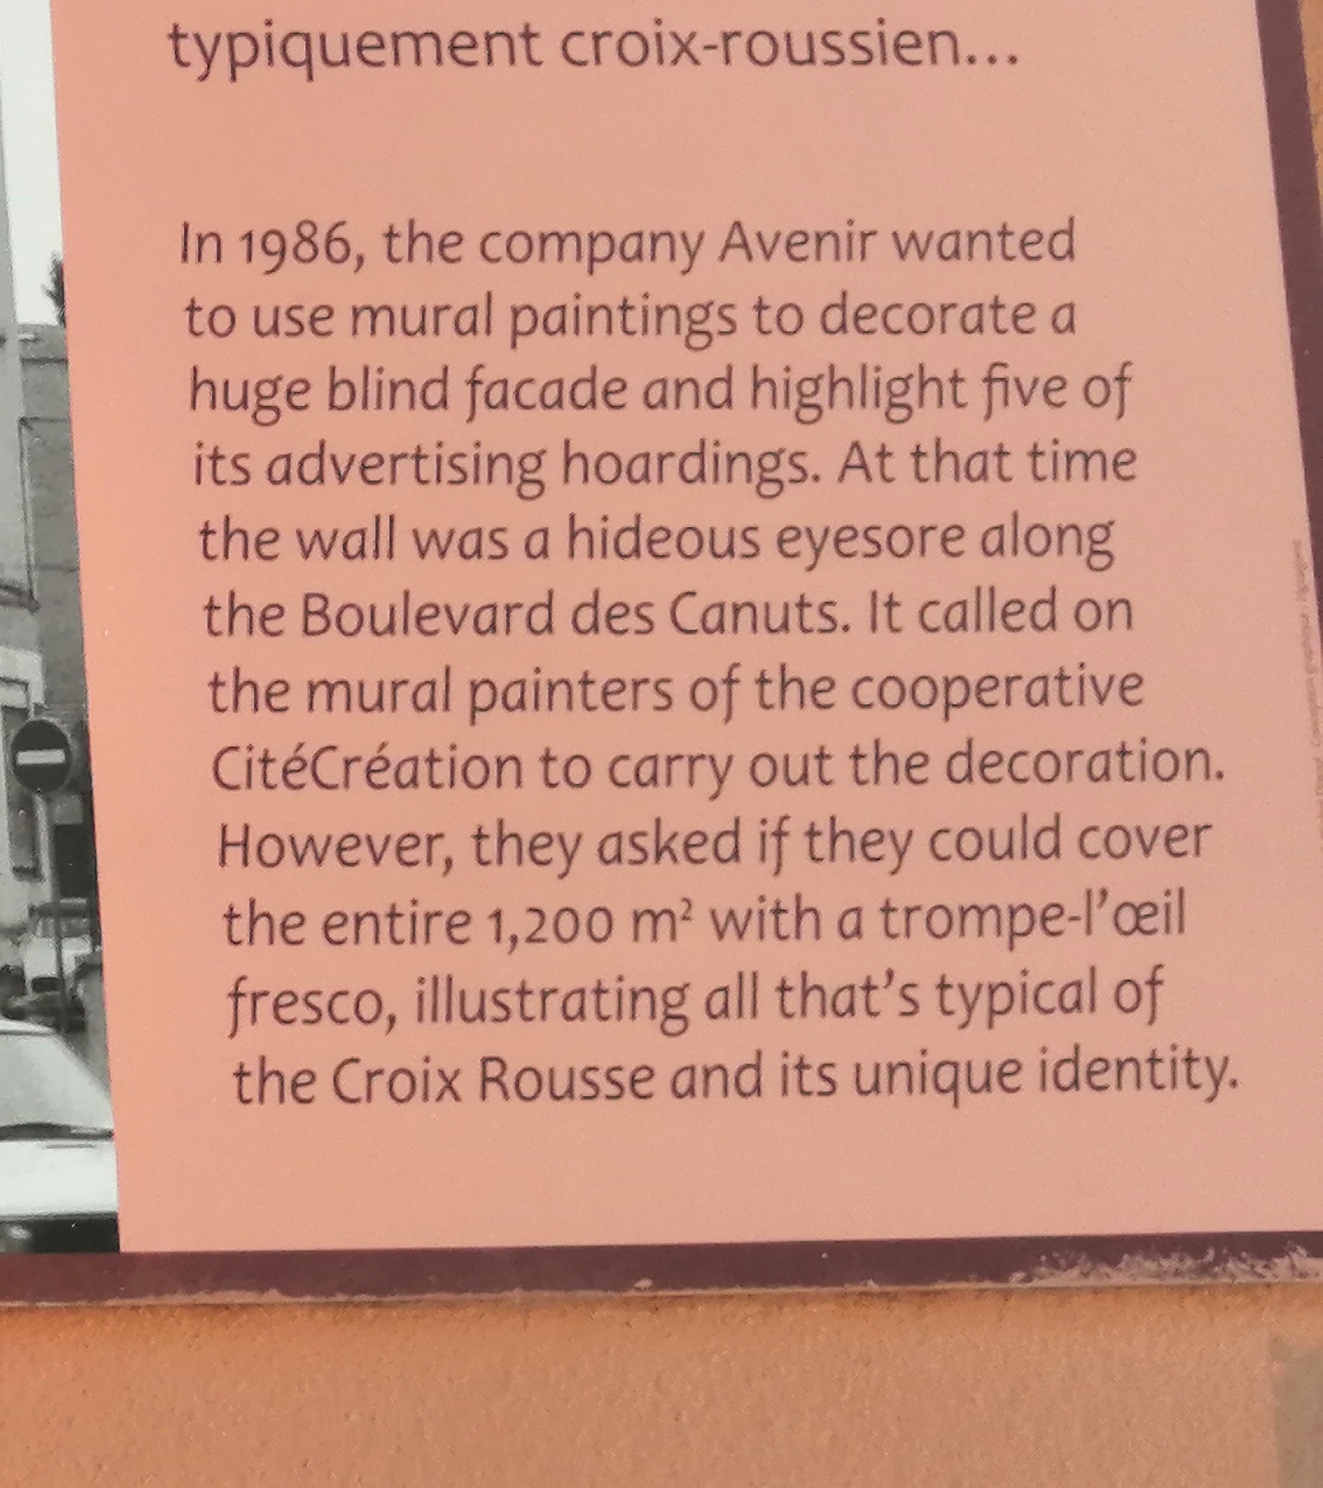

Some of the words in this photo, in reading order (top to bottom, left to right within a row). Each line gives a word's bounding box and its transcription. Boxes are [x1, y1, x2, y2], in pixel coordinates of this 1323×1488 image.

[166, 18, 544, 84] typiquement
[560, 16, 1019, 68] croix-roussien...
[180, 220, 223, 265] In
[238, 218, 366, 276] 1986,
[381, 217, 465, 265] the
[479, 229, 706, 277] company
[717, 218, 879, 264] Avenir
[890, 214, 1076, 263] wanted
[182, 296, 237, 339] to
[253, 303, 335, 339] use
[351, 290, 494, 338] mural
[510, 291, 738, 353] paintings
[751, 295, 805, 337] to
[819, 289, 1037, 337] decorate
[1050, 301, 1076, 335] a
[189, 364, 312, 428] huge
[328, 363, 450, 412] blind
[464, 363, 628, 425] facade
[642, 362, 734, 411] and
[750, 361, 969, 426] highlight
[981, 360, 1068, 423] five
[1082, 360, 1134, 422] of
[194, 440, 252, 487] its
[264, 438, 548, 502] advertising
[562, 437, 821, 501] hoardings.
[836, 440, 896, 484] At
[909, 435, 1014, 484] that
[1026, 437, 1138, 483] time
[197, 513, 281, 563] the
[295, 512, 396, 562] wall
[411, 526, 510, 561] was
[523, 526, 550, 561] a
[567, 511, 761, 561] hideous
[776, 523, 966, 573] eyesore
[979, 509, 1116, 573] along
[202, 589, 286, 638] the
[301, 587, 555, 638] Boulevard
[570, 587, 655, 637] des
[668, 590, 852, 636] Canuts.
[869, 589, 903, 635] It
[917, 584, 1058, 634] called
[1073, 597, 1134, 633] on
[206, 664, 291, 715] the
[306, 664, 452, 714] mural
[468, 666, 674, 728] painters
[688, 661, 742, 725] of
[753, 662, 837, 711] the
[851, 661, 1145, 724] cooperative
[211, 741, 524, 792] CitéCréation
[538, 746, 593, 790] to
[607, 752, 735, 802] carry
[748, 744, 835, 789] out
[848, 737, 931, 787] the
[945, 735, 1225, 786] decoration.
[218, 822, 454, 878] However,
[470, 817, 584, 881] they
[596, 815, 742, 867] asked
[759, 813, 792, 878] if
[803, 814, 914, 877] they
[928, 811, 1062, 863] could
[1077, 823, 1214, 861] cover
[222, 896, 307, 947] the
[320, 897, 473, 947] entire
[487, 905, 614, 956] 1,200
[708, 891, 822, 942] with
[836, 905, 864, 942] a
[226, 974, 397, 1041] fresco,
[416, 973, 691, 1038] illustrating
[704, 969, 759, 1021] all
[934, 965, 1097, 1031] typical
[1113, 962, 1165, 1027] of
[232, 1054, 318, 1106] the
[332, 1055, 463, 1105] Croix
[479, 1055, 656, 1104] Rousse
[669, 1048, 764, 1100] and
[780, 1050, 840, 1098] its
[853, 1047, 1024, 1110] unique
[1039, 1041, 1239, 1104] identity.
